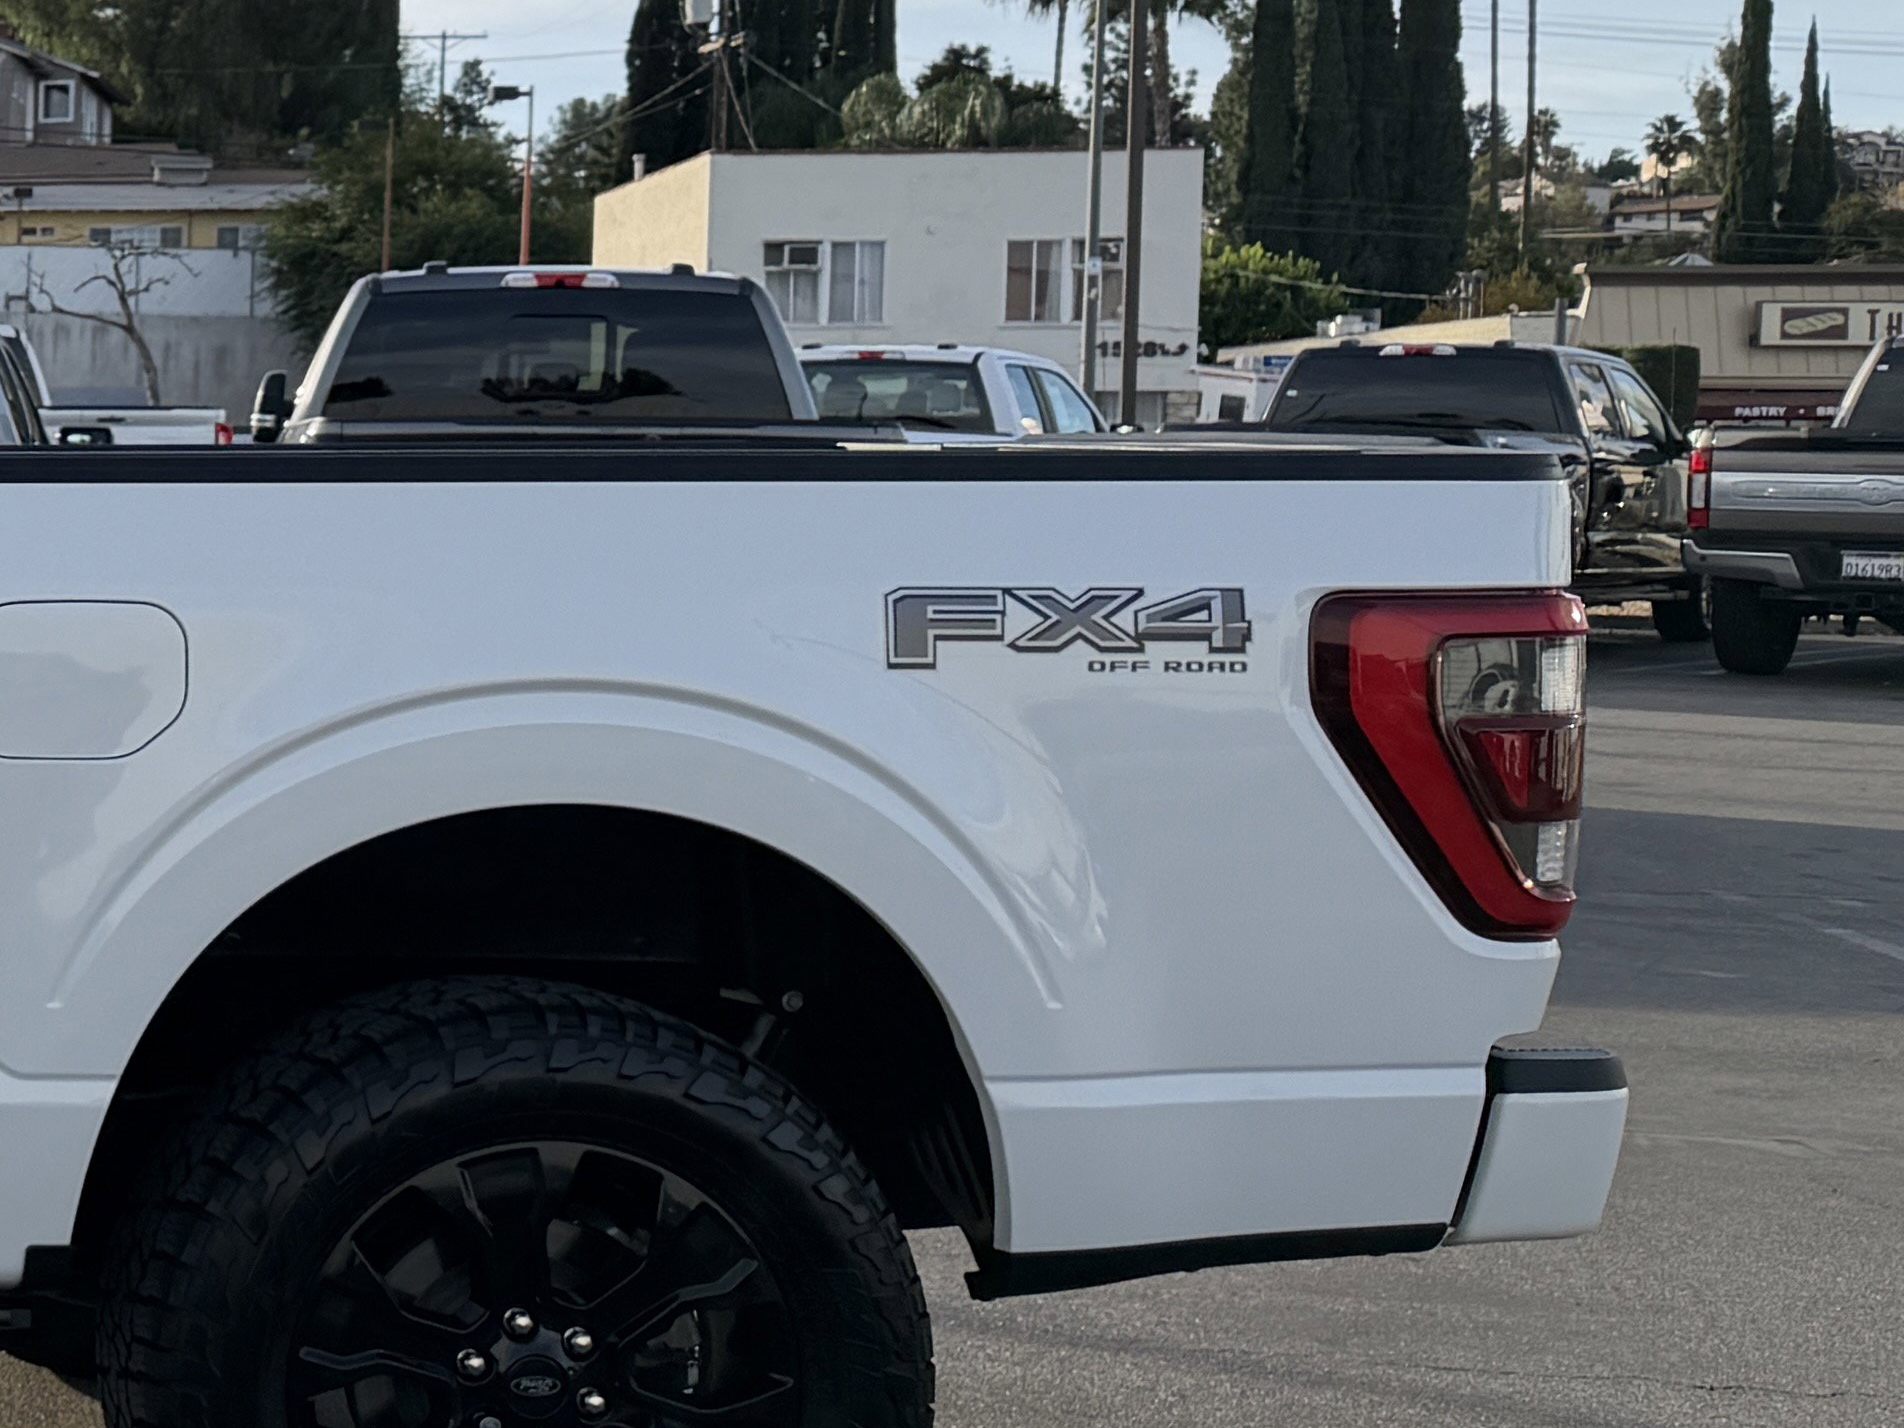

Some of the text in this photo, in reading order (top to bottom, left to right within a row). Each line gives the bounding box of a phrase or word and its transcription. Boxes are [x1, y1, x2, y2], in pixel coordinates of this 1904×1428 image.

[1734, 405, 1787, 417] PASTRY
[884, 587, 1252, 670] FX4
[1087, 660, 1248, 674] OFF ROAD
